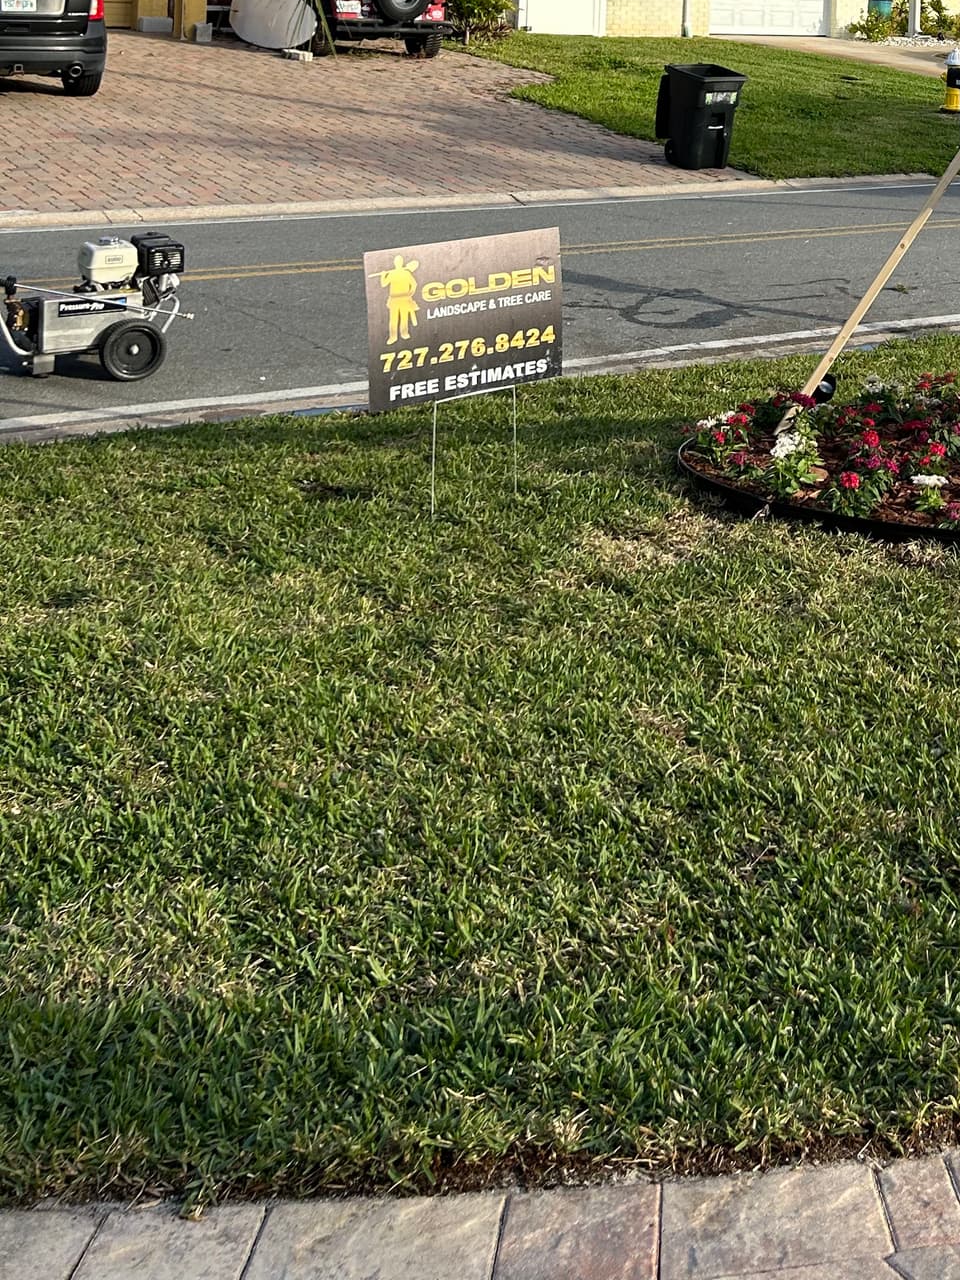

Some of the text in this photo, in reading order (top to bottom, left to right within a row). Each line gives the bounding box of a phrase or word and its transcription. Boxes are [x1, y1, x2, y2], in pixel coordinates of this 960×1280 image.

[421, 266, 555, 302] GOLDEN
[426, 289, 552, 320] LANDSCAPE & TREE CARE
[380, 325, 555, 373] 727.276.8424
[389, 358, 548, 402] FREE ESTIMATES
